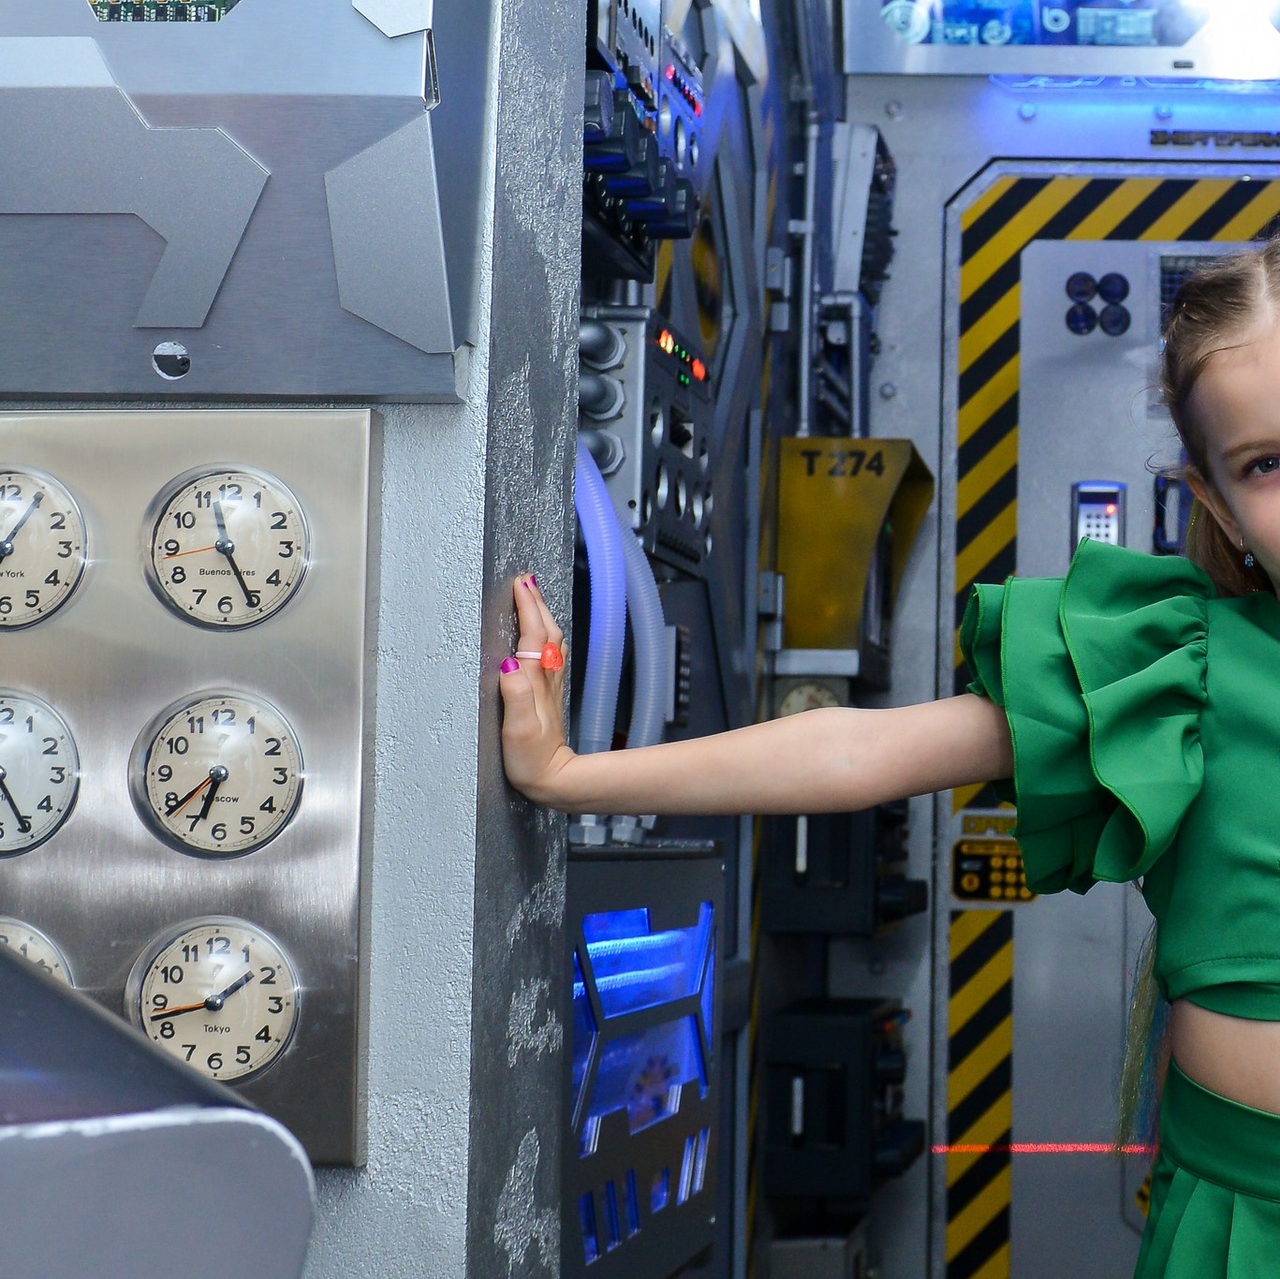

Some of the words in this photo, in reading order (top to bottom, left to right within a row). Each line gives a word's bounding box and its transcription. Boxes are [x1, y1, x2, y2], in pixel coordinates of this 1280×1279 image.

[828, 450, 885, 477] 274
[195, 490, 211, 508] 11
[218, 484, 243, 501] 12
[253, 491, 262, 508] 1
[50, 512, 66, 530] 2
[173, 511, 196, 529] 10
[270, 512, 287, 530] 2
[58, 541, 73, 558] 3
[164, 539, 180, 556] 9
[278, 541, 294, 558] 3
[5, 570, 25, 579] York
[44, 569, 60, 586] 4
[171, 566, 187, 584] 8
[199, 568, 231, 577] Buenos
[234, 568, 256, 577] ires
[266, 569, 281, 586] 4
[25, 590, 40, 608] 5
[192, 589, 207, 605] 7
[217, 596, 233, 614] 6
[26, 715, 34, 733] 1
[187, 716, 204, 734] 11
[211, 708, 236, 726] 12
[246, 716, 256, 734] 1
[42, 737, 58, 755] 2
[166, 736, 189, 755] 10
[264, 737, 282, 756] 2
[50, 767, 65, 784] 3
[157, 764, 173, 782] 9
[273, 767, 288, 785] 3
[37, 795, 53, 813] 4
[165, 791, 179, 809] 8
[259, 796, 276, 814] 4
[186, 815, 201, 832] 7
[211, 823, 227, 841] 6
[239, 816, 255, 835] 5
[182, 945, 199, 962] 11
[205, 937, 231, 955] 12
[241, 945, 250, 962] 1
[160, 965, 184, 984] 10
[259, 967, 276, 985] 2
[152, 994, 168, 1012] 9
[268, 996, 283, 1014] 3
[160, 1021, 175, 1039] 8
[203, 1024, 231, 1035] Tokyo
[255, 1025, 272, 1043] 4
[181, 1044, 197, 1062] 7
[207, 1053, 223, 1070] 6
[235, 1046, 251, 1064] 5
